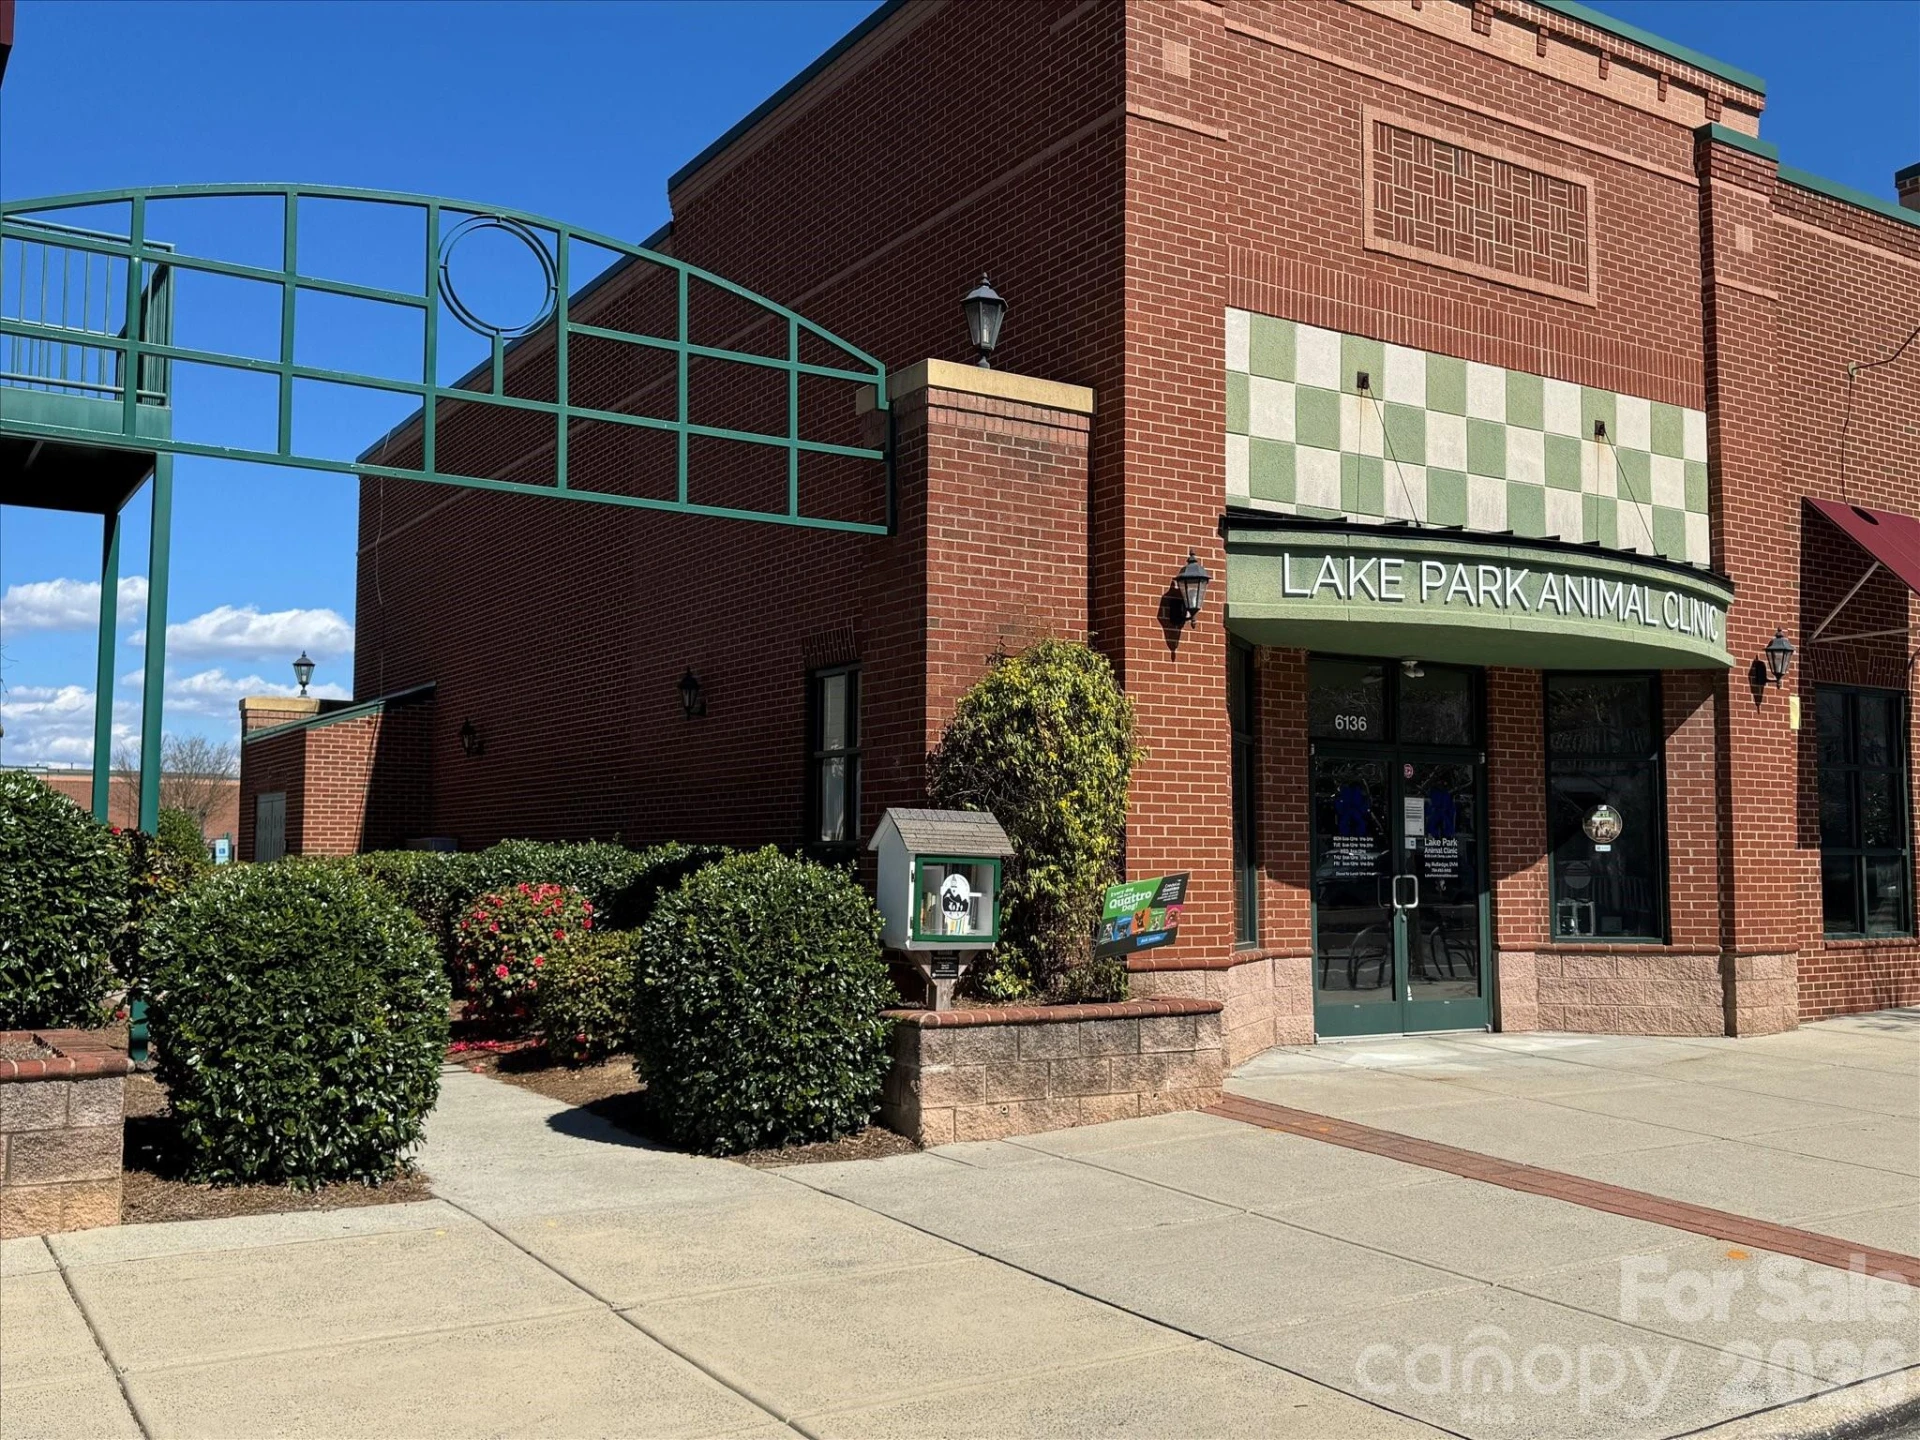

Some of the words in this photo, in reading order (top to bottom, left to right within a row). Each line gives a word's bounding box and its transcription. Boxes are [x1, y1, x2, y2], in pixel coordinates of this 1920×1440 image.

[1282, 552, 1405, 599] LAKE
[1419, 560, 1531, 610] PARK
[1536, 571, 1659, 626] ANIMAL
[1662, 590, 1720, 641] CLINIC
[1334, 714, 1368, 732] 6136
[1424, 837, 1441, 847] Lake
[1442, 837, 1458, 847] Park
[1109, 891, 1152, 909] Quattro
